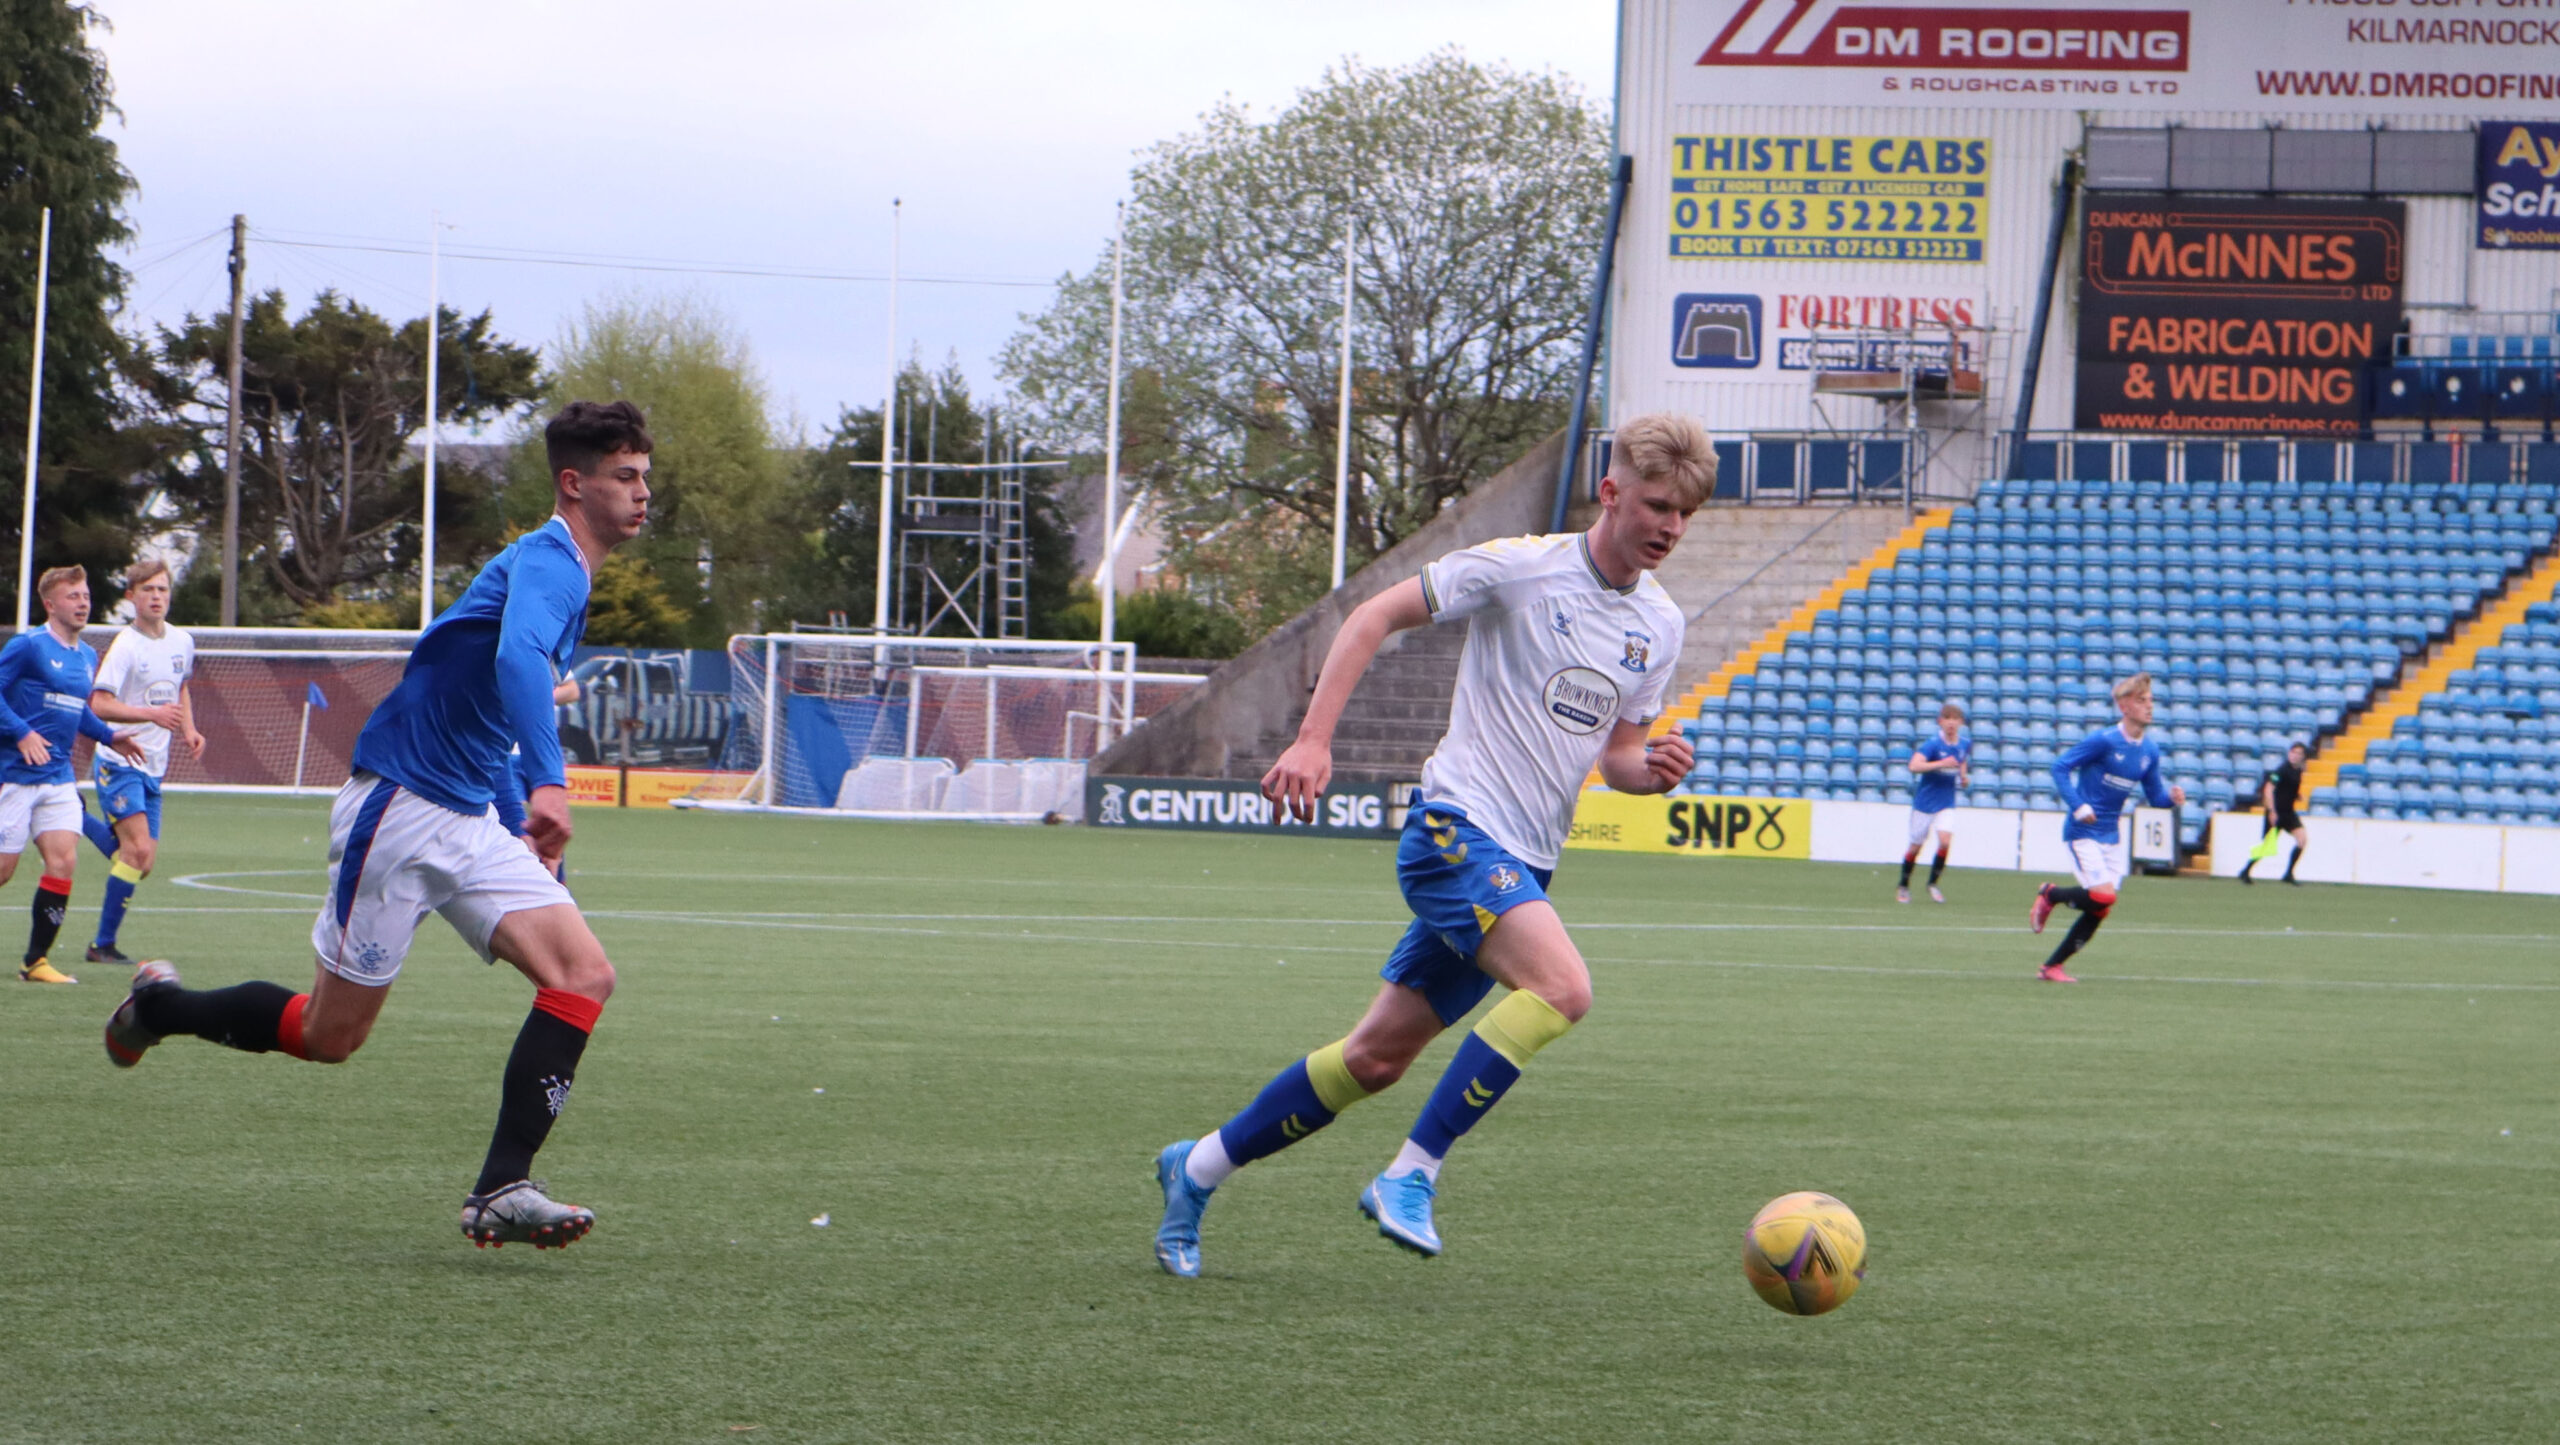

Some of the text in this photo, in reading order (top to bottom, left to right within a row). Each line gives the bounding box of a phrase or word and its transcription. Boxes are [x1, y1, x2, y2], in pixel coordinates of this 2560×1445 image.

[1835, 27, 2180, 60] DM ROOFING
[2348, 18, 2560, 45] KILMARNOCK
[1882, 77, 2179, 95] & ROUGHCASTING LTD
[2255, 70, 2560, 100] WWW.DMROOFIN
[1674, 137, 1987, 175] THISTLE CABS
[1693, 180, 1720, 192] GET
[1724, 181, 1767, 193] HOME
[1770, 181, 1804, 193] SAFE
[1817, 182, 1846, 195] GET
[1848, 182, 1861, 195] A
[1863, 182, 1931, 195] LICENSED
[1934, 183, 1966, 196] CAB
[1674, 198, 1978, 233] 01563 522222
[2089, 211, 2164, 228] DUNCAN
[1679, 236, 1967, 258] BOOK BY TEXT: 07563 52222
[2127, 231, 2357, 281] McINNES
[2361, 284, 2393, 301] LTD
[1777, 294, 1974, 330] FORTRESS
[2108, 316, 2373, 358] FABRICATION
[2123, 362, 2355, 404] & WELDING
[1554, 675, 1615, 716] BROWNINGS
[1327, 793, 1382, 828] SIG
[1667, 800, 1751, 849] SNP
[2145, 821, 2162, 847] 16
